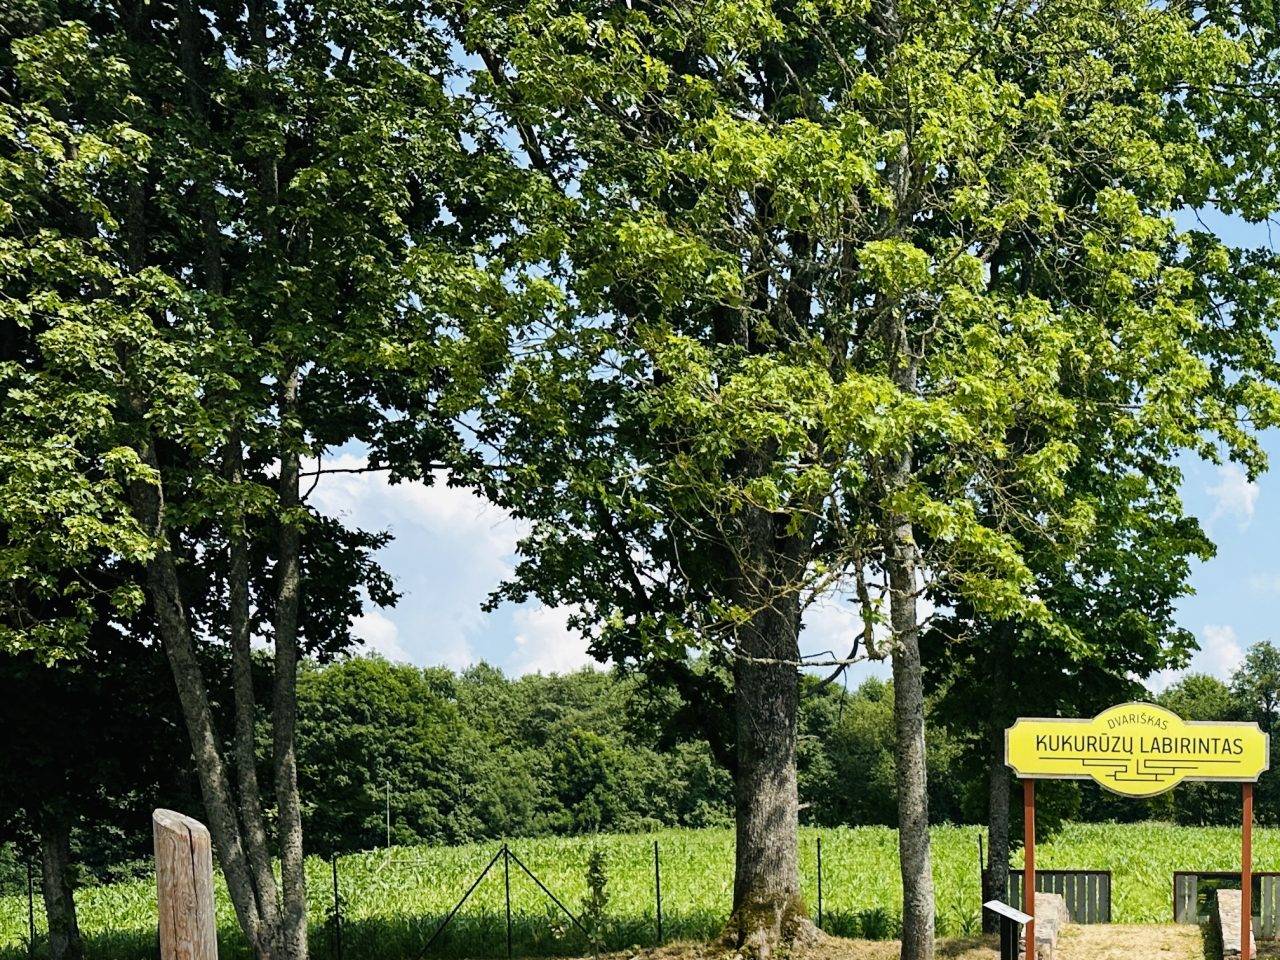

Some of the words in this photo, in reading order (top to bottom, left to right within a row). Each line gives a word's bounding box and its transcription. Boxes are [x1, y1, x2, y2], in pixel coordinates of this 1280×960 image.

[1107, 713, 1168, 730] DVARIŠKAS
[1036, 733, 1133, 755] KUKURŪZŲ
[1140, 736, 1244, 755] LABIRINTAS
